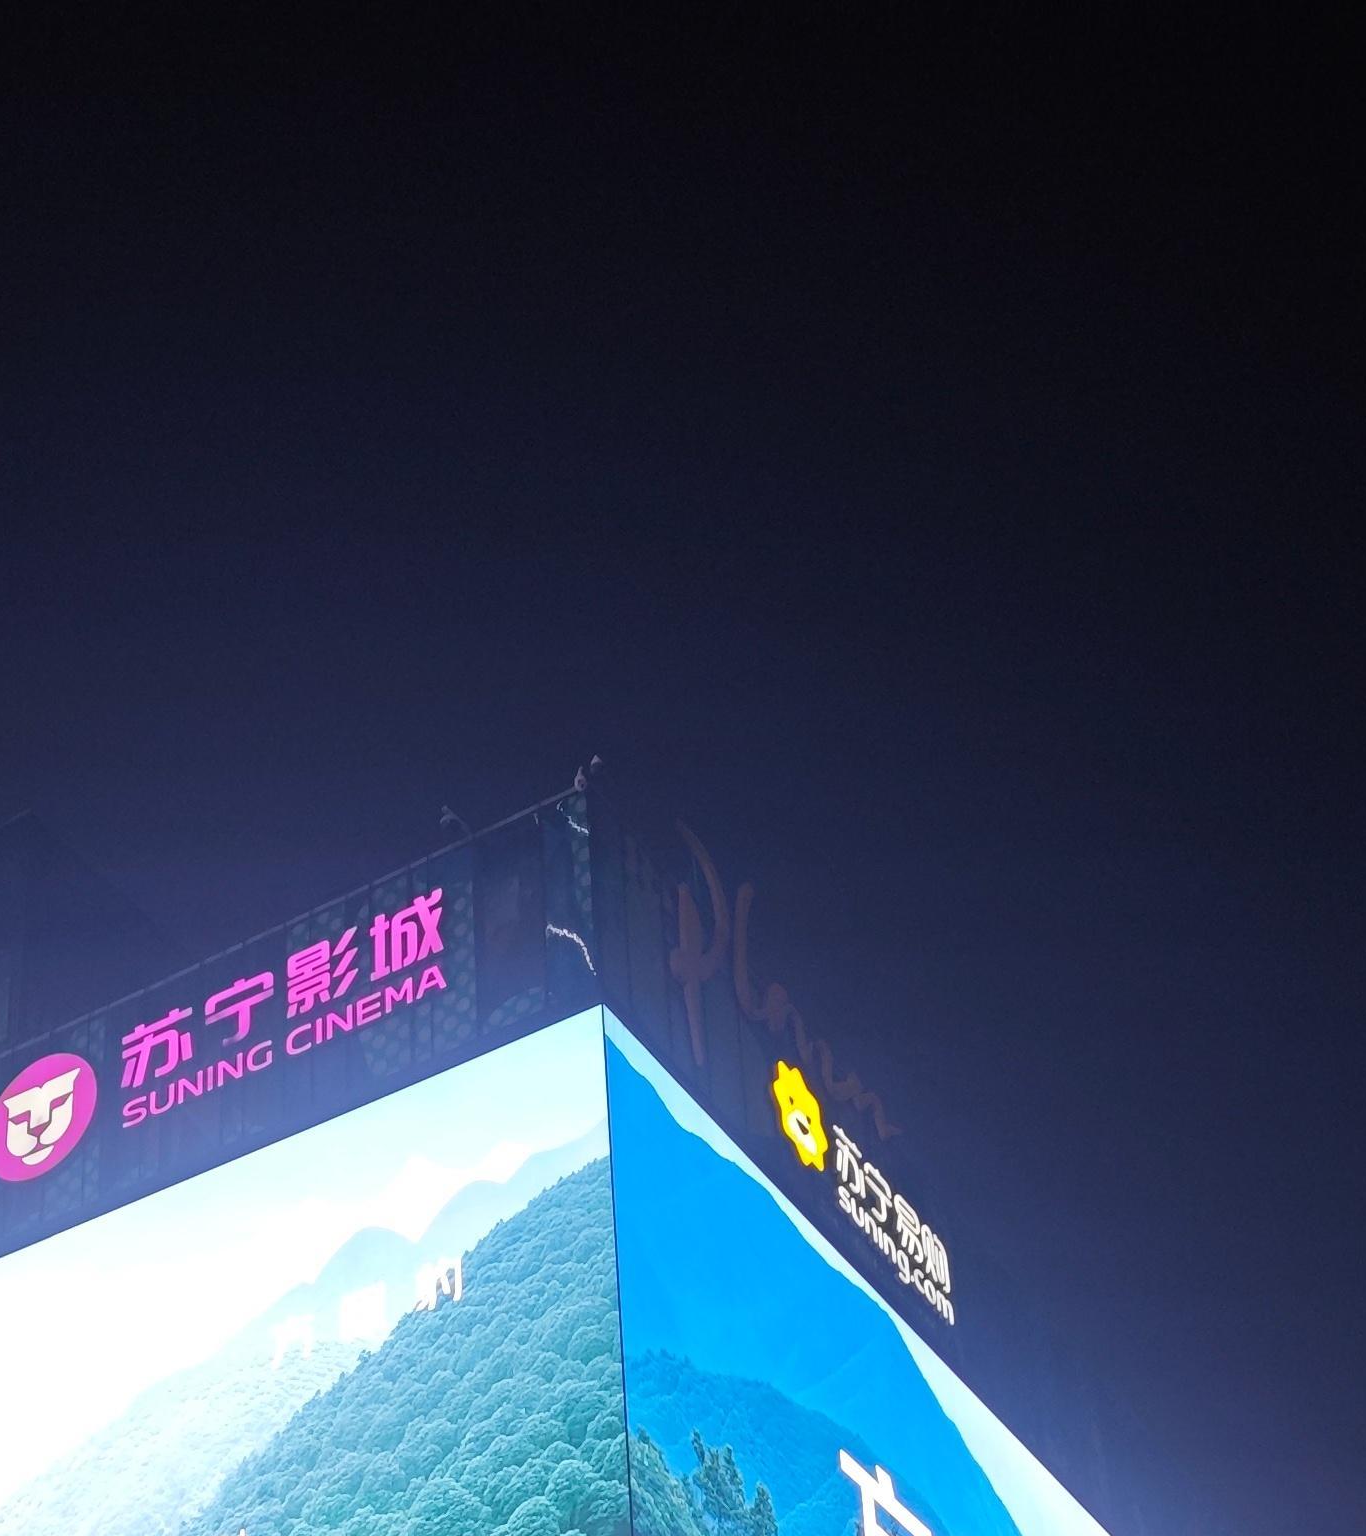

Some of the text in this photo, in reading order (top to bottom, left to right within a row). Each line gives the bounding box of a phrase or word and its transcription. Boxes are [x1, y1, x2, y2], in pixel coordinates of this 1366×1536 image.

[121, 886, 444, 1090] 苏宁影城
[122, 965, 447, 1128] SUNING CINEMA
[833, 1125, 952, 1293] 苏宁易购
[838, 1186, 955, 1326] suning.com
